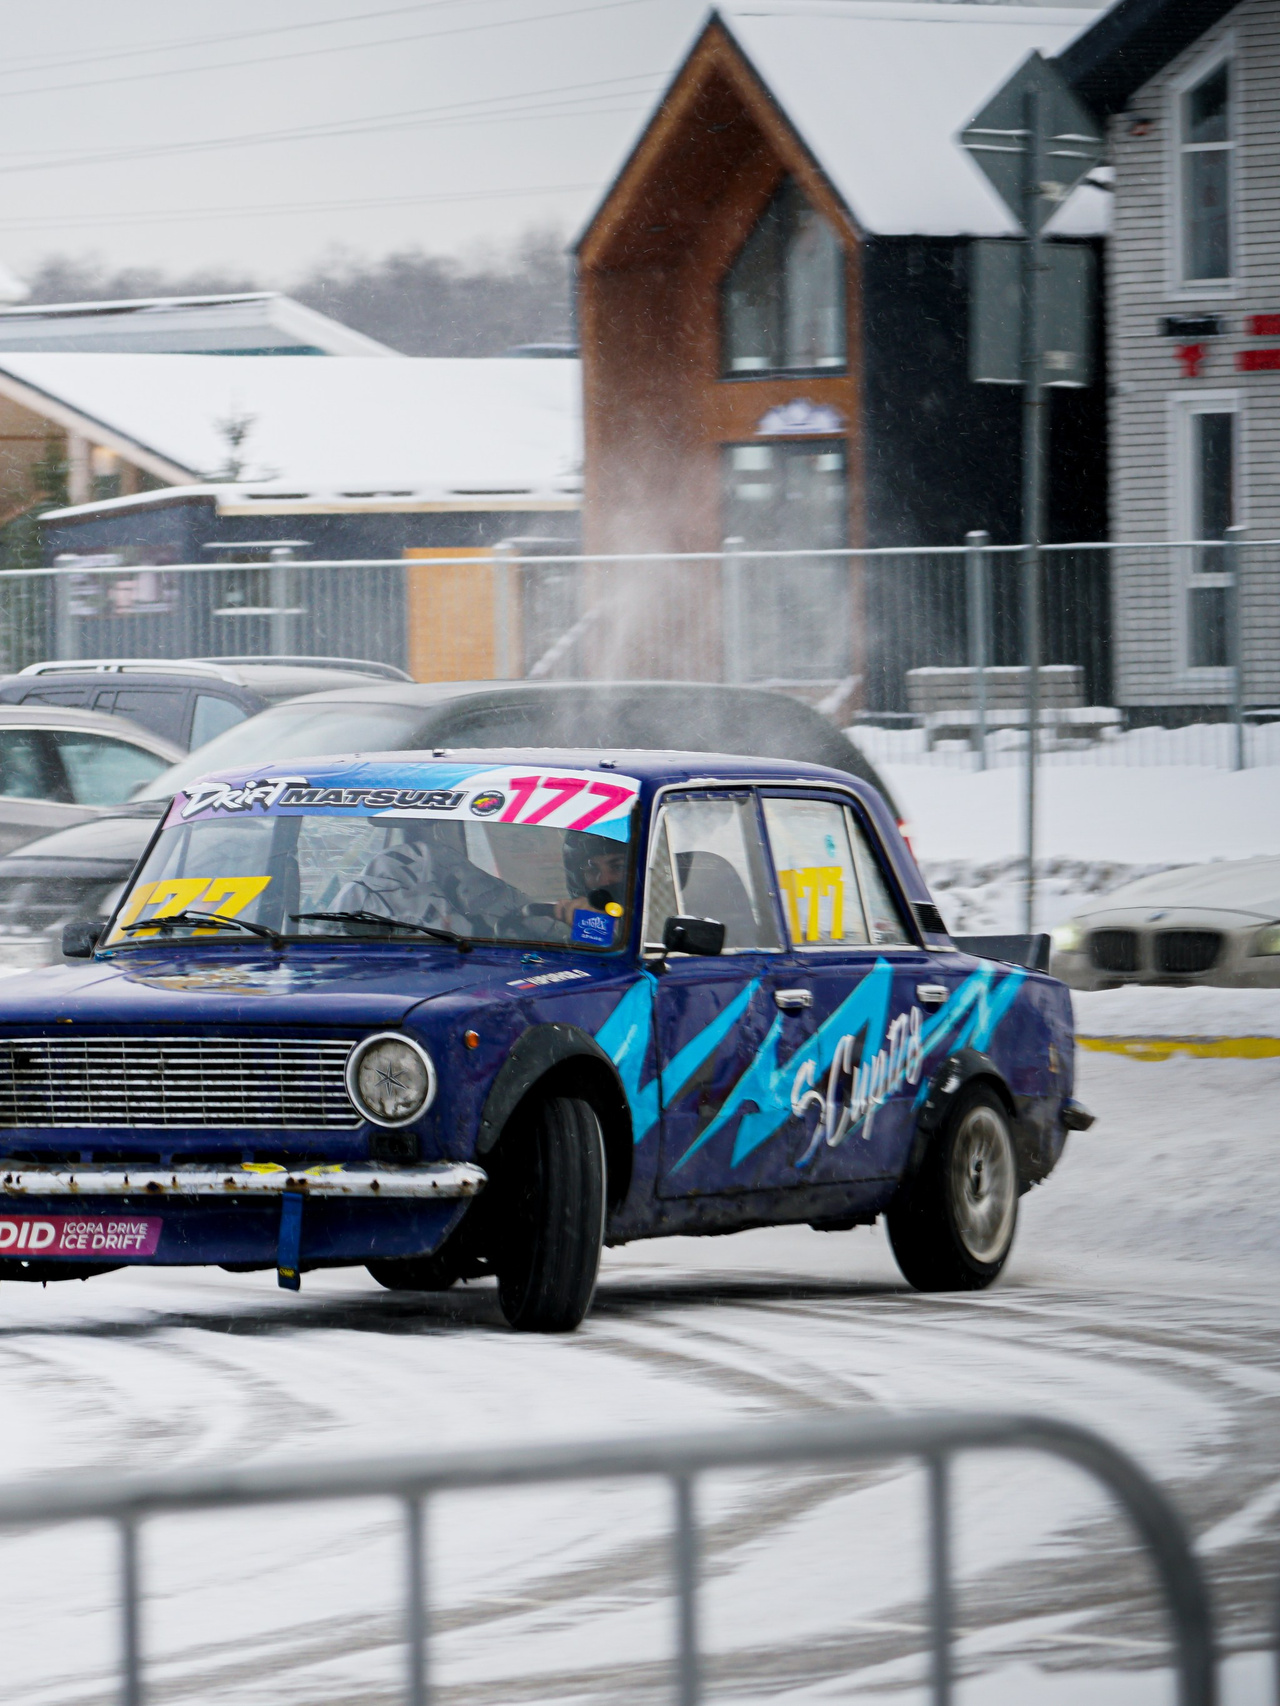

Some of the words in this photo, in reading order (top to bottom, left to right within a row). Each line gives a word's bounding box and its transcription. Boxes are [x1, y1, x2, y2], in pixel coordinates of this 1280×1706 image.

[279, 788, 469, 810] MATSURI
[499, 776, 638, 831] 177
[109, 875, 273, 944] 177
[777, 866, 845, 944] 177
[58, 1234, 90, 1249] ICE
[91, 1234, 147, 1250] DRIFT
[63, 1222, 104, 1235] IGORA
[107, 1222, 149, 1235] DRIVE
